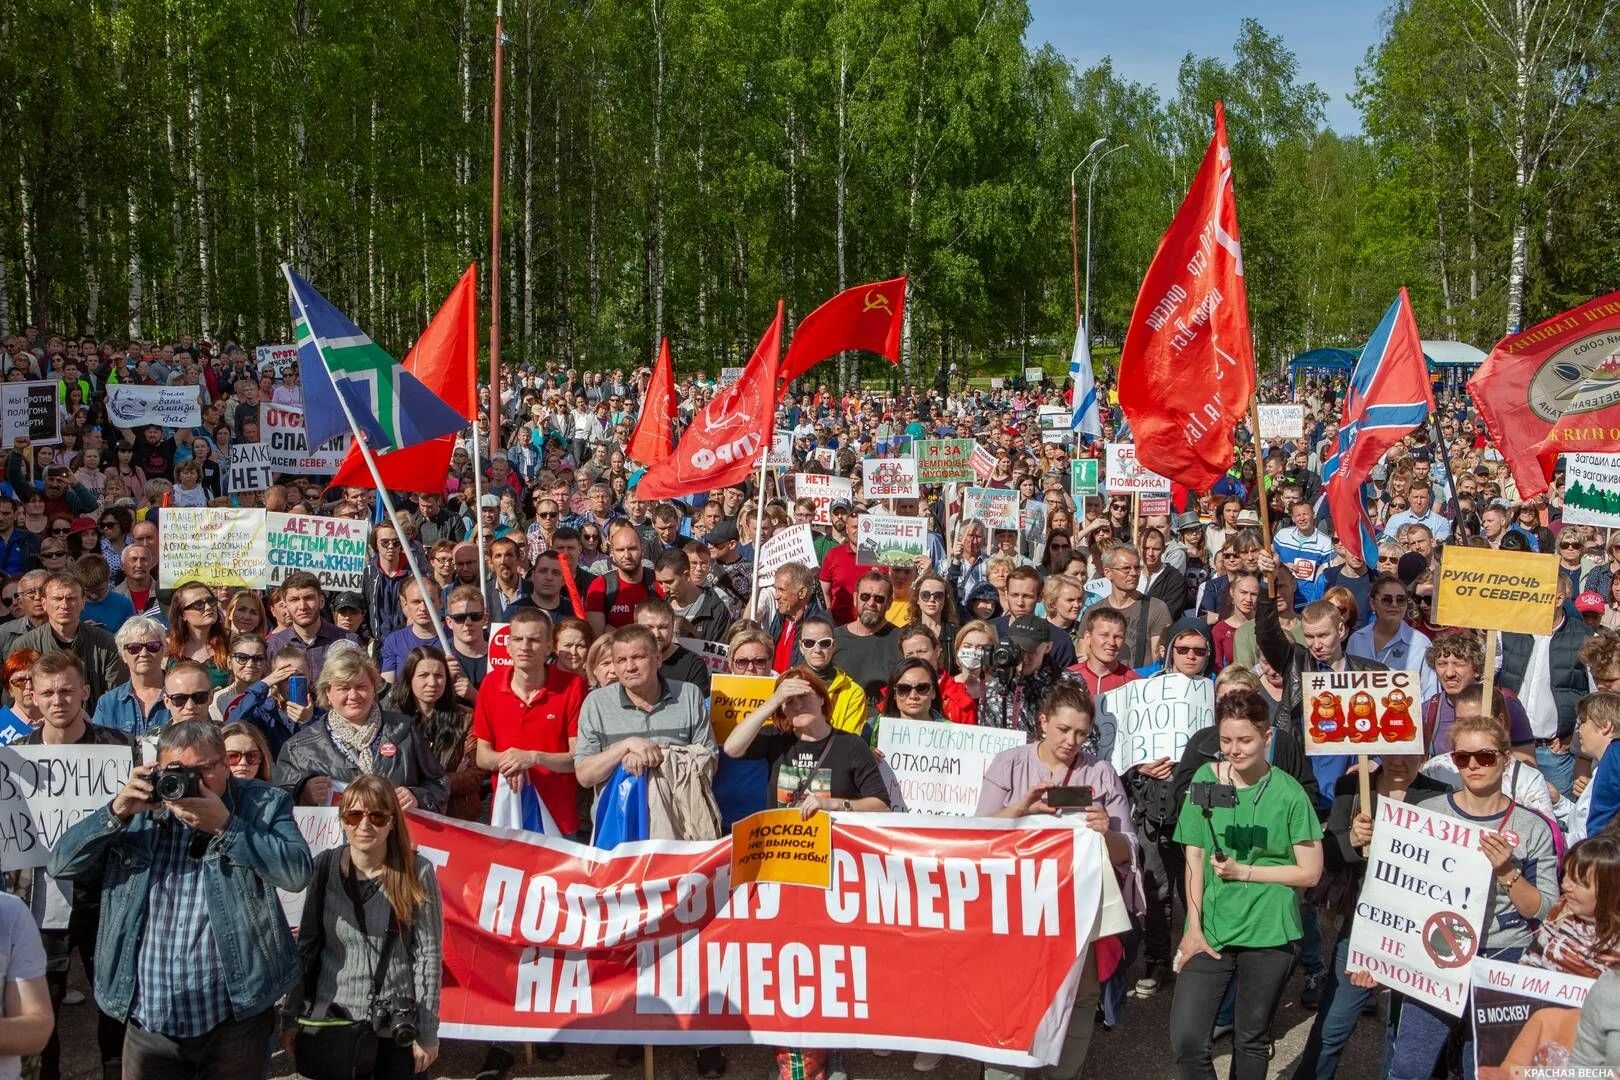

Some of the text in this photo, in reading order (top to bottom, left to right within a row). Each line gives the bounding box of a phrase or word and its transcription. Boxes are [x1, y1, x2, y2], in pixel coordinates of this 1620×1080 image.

[23, 395, 53, 404] ПРОТИВ
[7, 407, 49, 417] ПОЛИГОНА
[14, 419, 44, 428] СМЕРТИ
[929, 446, 961, 456] Я ЗА
[1117, 448, 1137, 459] СЕ
[299, 459, 327, 467] СЕВЕР
[918, 460, 952, 468] ЗЕМЛЮ
[1575, 453, 1610, 466] Загадил
[880, 463, 903, 471] Я ЗА
[1569, 465, 1581, 477] Не
[230, 466, 270, 490] НЕТ
[806, 475, 830, 486] НЕТ!
[868, 475, 914, 483] ЧИСТОТУ
[1110, 477, 1166, 488] ПОМОЙКА!
[870, 486, 913, 494] СЕВЕРА!
[895, 524, 923, 537] НЕТ
[268, 548, 313, 568] СЕВЕР
[271, 566, 280, 582] А
[1442, 570, 1541, 588] РУКИ ПРОЧЬ
[1456, 585, 1555, 604] ОТ СЕВЕРА!!!
[1311, 672, 1410, 690] #ШИЕС
[714, 696, 747, 708] РУКИ
[724, 710, 741, 719] ОТ
[891, 725, 911, 745] НА
[918, 726, 981, 751] РУССКОМ
[890, 752, 961, 776] ОТХОДАМ
[748, 824, 820, 839] МОСКВА!
[777, 851, 793, 860] из
[1390, 838, 1457, 873] ВОН С
[824, 847, 1061, 937] СМЕРТИ
[1380, 936, 1407, 959] НЕ
[514, 929, 870, 1020] НА ШИЕСЕ!
[1488, 969, 1517, 989] МЫ
[1520, 976, 1551, 995] ИМ
[1477, 1005, 1531, 1024] В МОСКВУ
